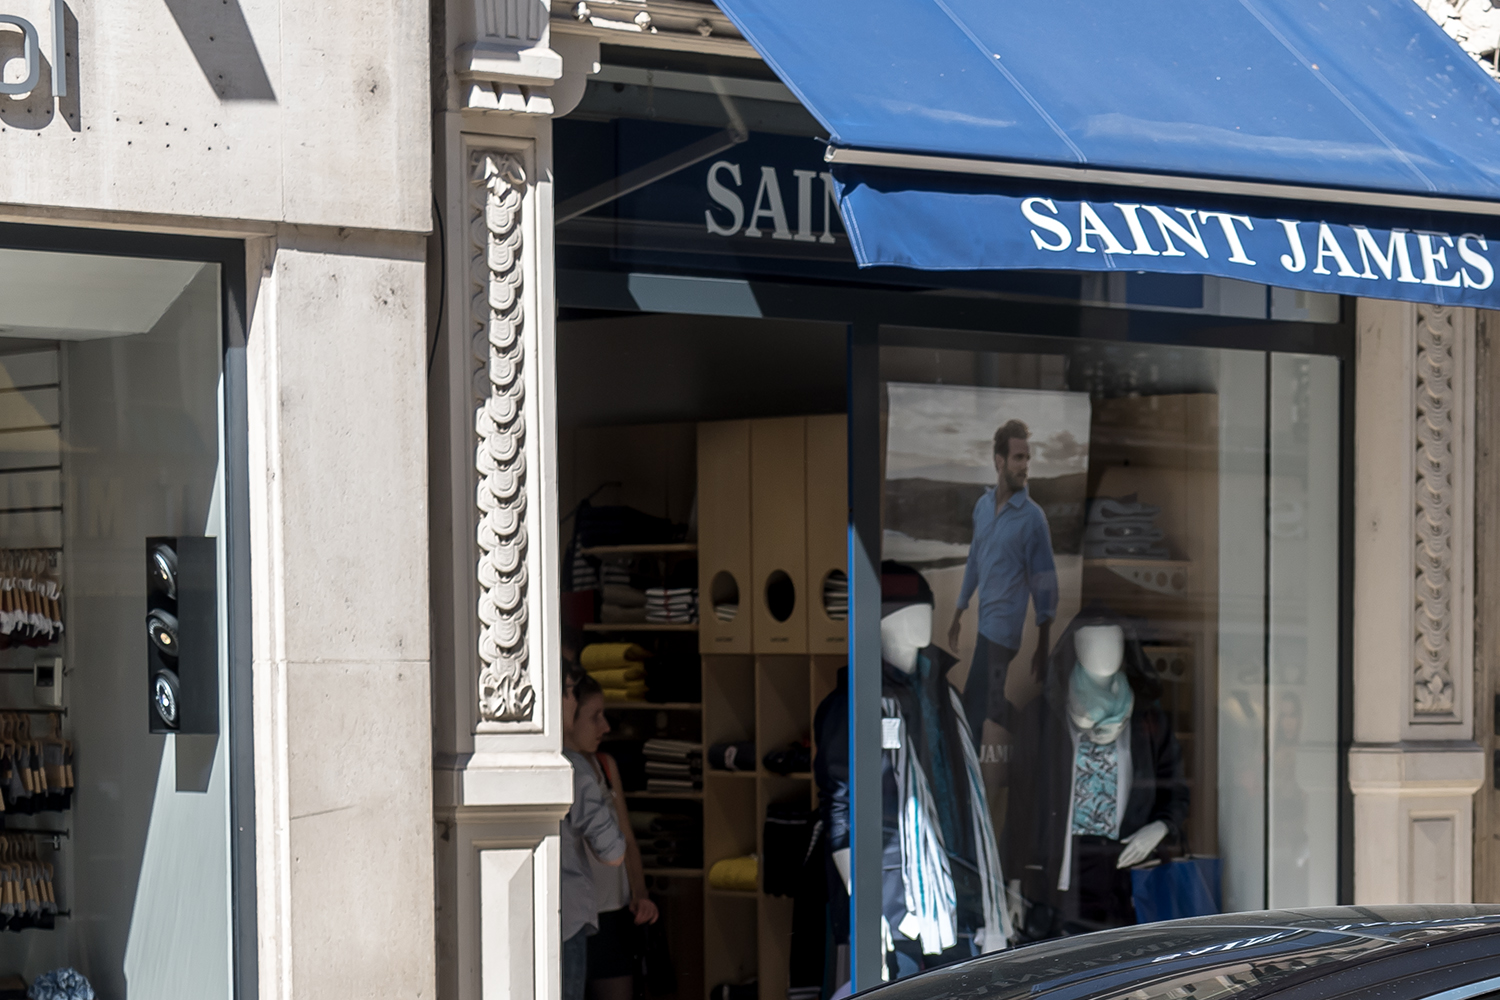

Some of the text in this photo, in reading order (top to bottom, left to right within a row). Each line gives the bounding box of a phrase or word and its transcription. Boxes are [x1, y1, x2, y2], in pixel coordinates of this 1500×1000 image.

[705, 160, 847, 244] SAIN
[1020, 197, 1495, 291] SAINT JAMES
